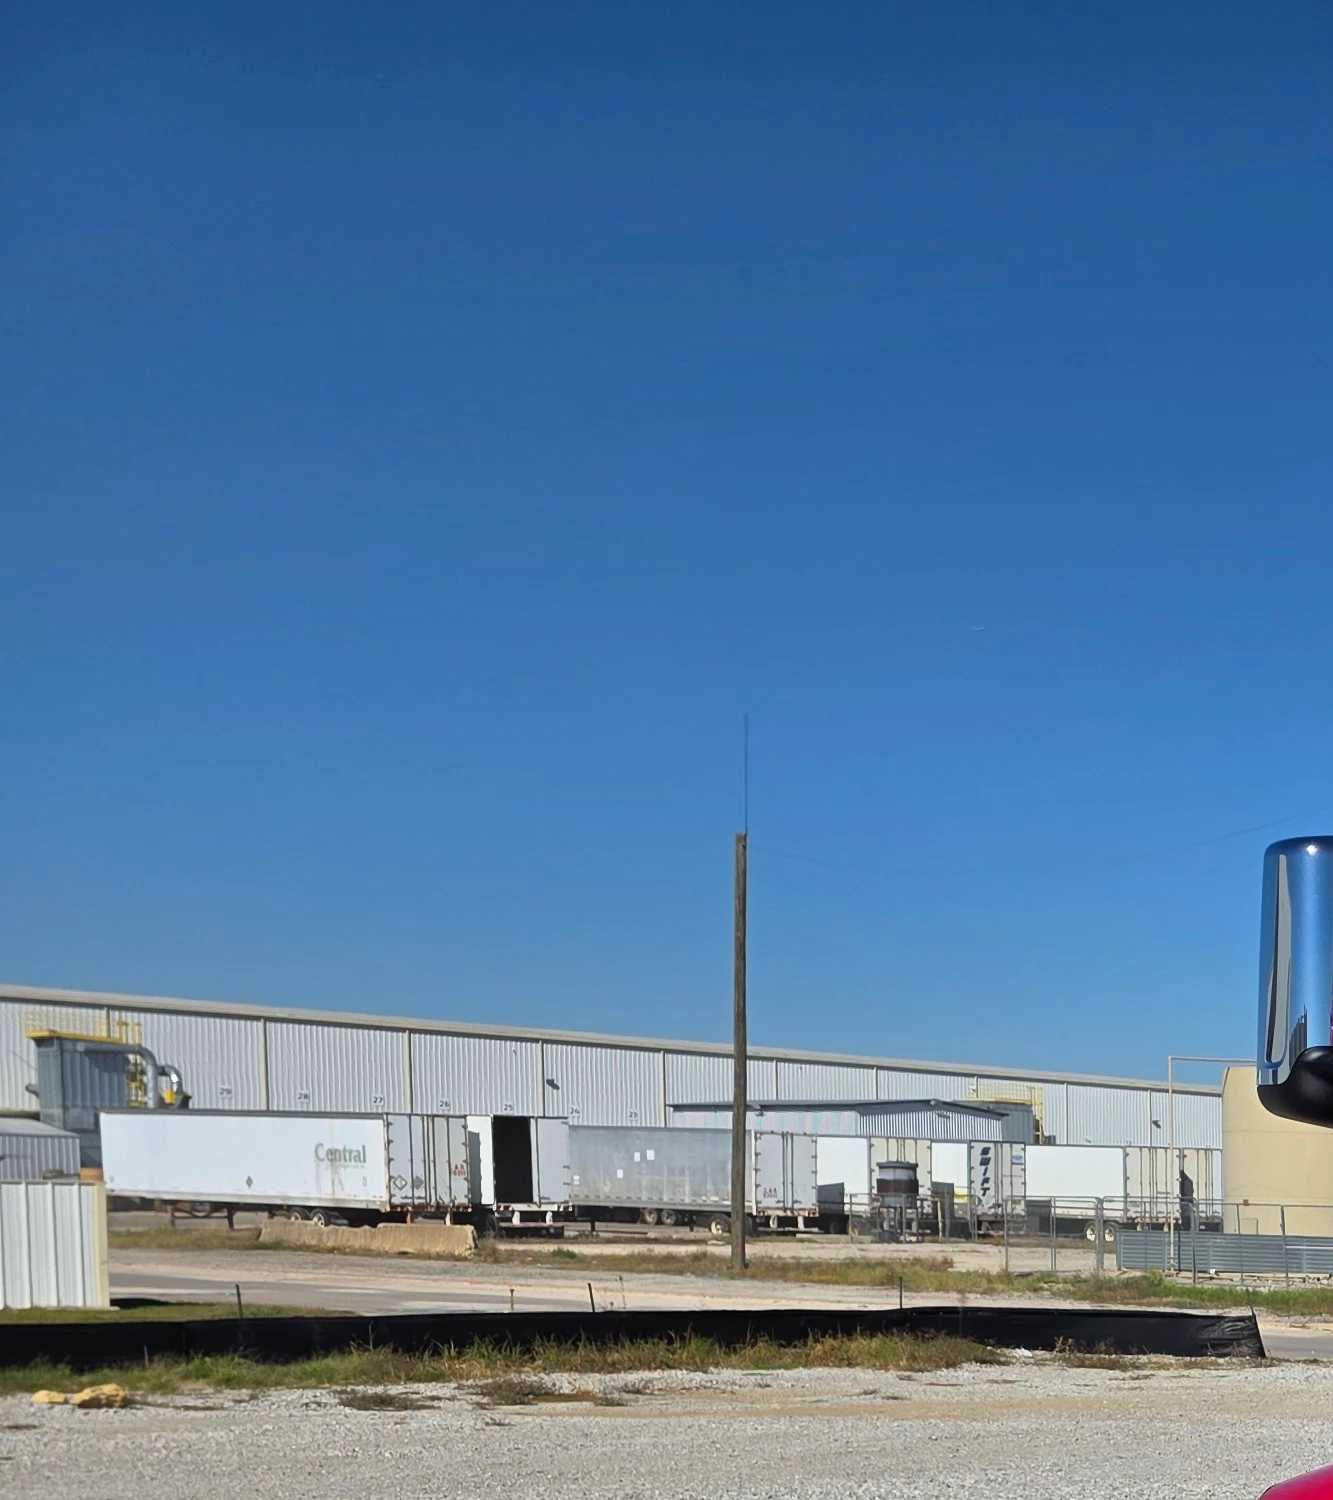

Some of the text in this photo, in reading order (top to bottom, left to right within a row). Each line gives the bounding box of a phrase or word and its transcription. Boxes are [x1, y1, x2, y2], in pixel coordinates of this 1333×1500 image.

[373, 1096, 383, 1104] 27
[314, 1142, 367, 1164] Central
[979, 1146, 991, 1197] SWIFT
